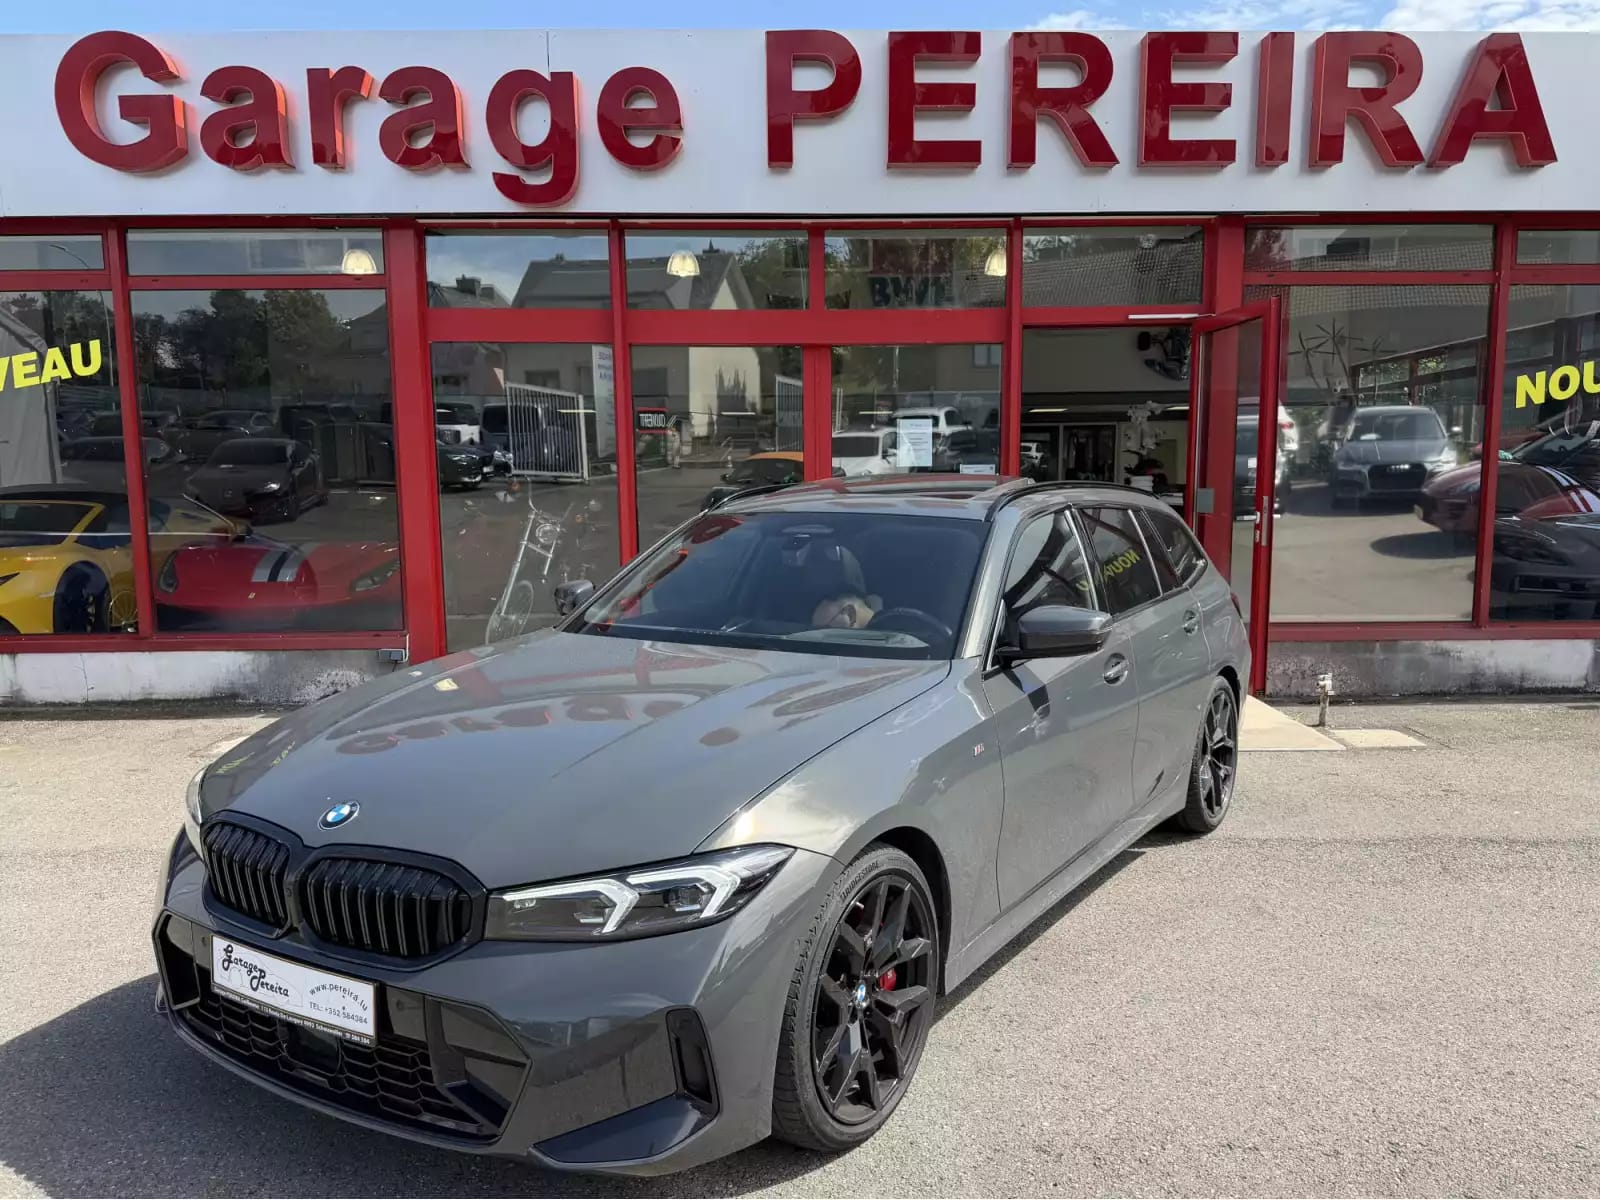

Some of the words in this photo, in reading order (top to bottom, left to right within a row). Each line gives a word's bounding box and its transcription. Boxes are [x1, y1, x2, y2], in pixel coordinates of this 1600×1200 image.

[55, 30, 684, 207] Garage
[766, 29, 1558, 169] PEREIRA
[222, 944, 258, 976] Garage
[250, 968, 290, 997] Pereira
[309, 983, 368, 1011] www.pereira.lu
